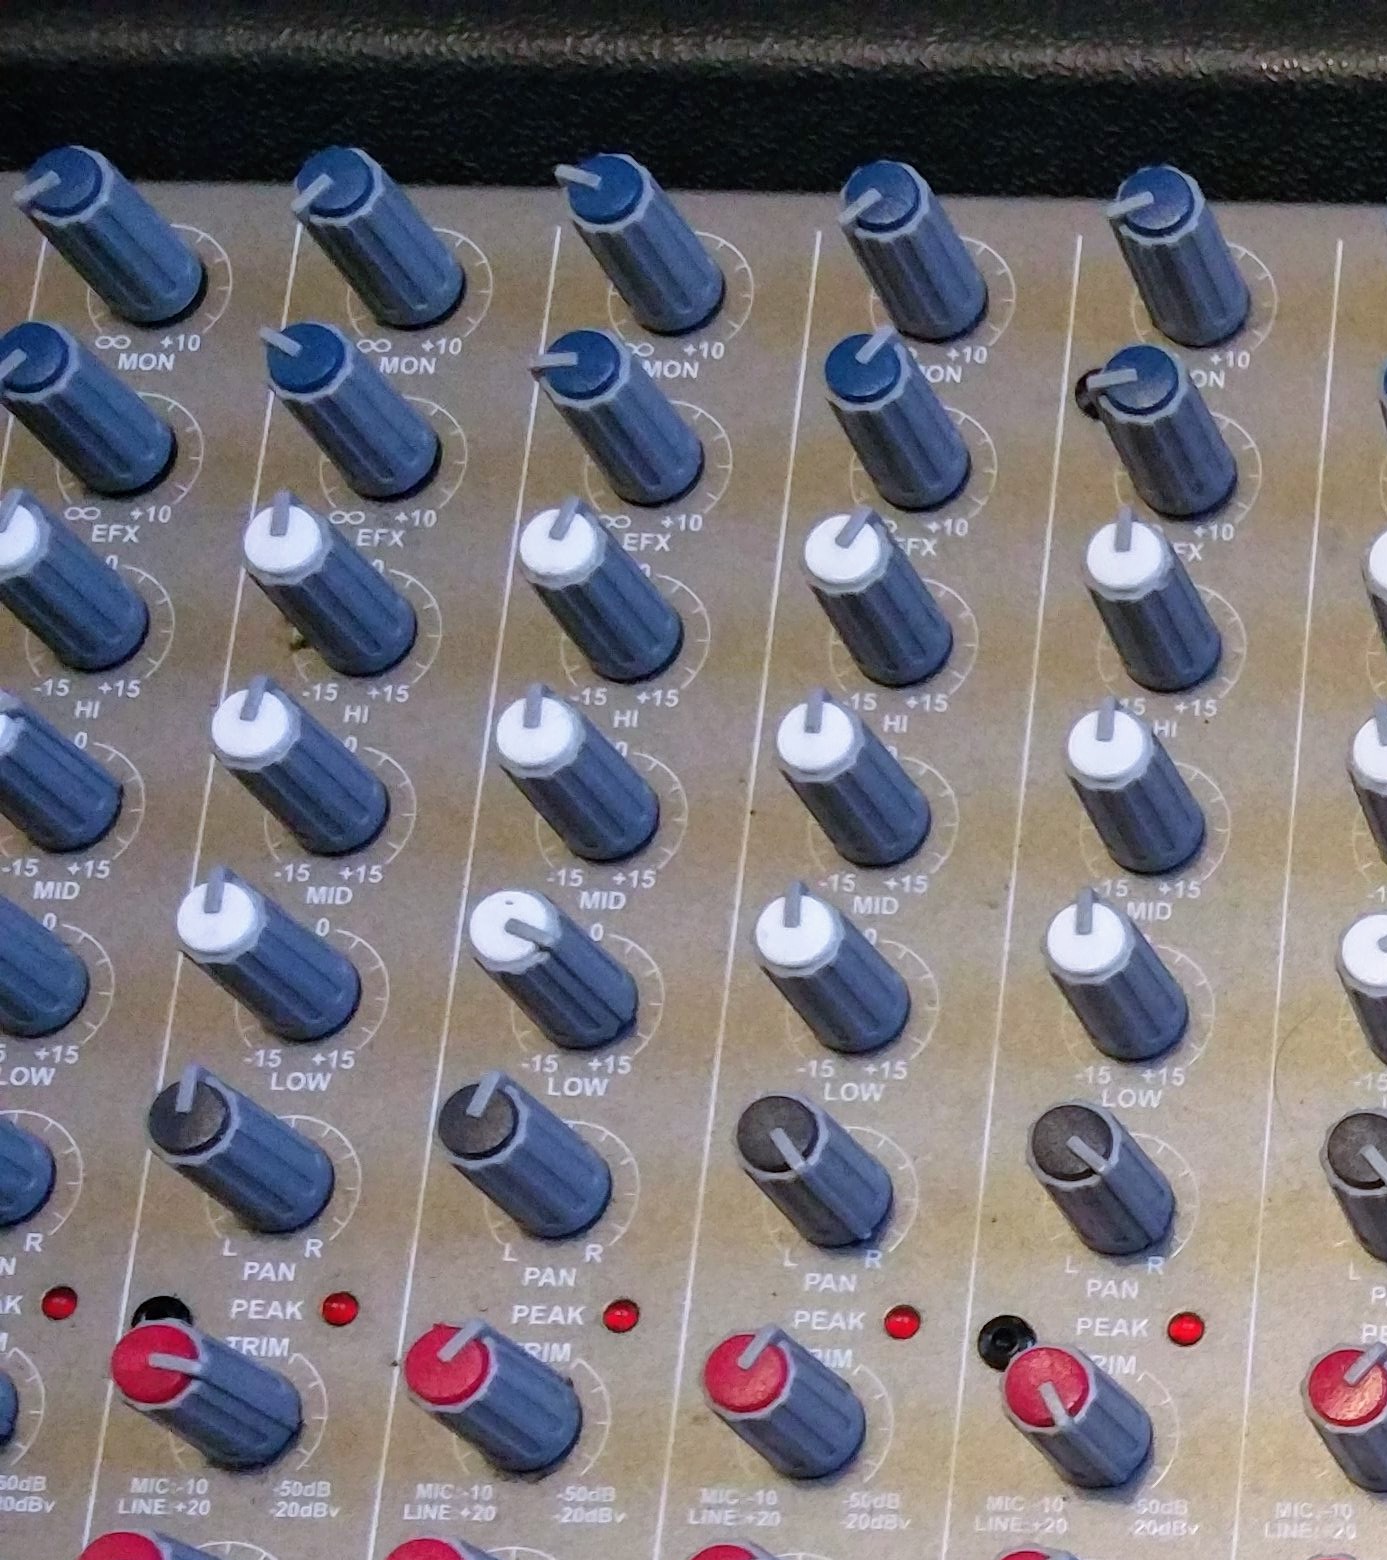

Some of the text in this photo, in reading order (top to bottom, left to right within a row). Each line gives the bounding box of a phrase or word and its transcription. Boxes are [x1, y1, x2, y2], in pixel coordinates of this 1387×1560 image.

[118, 353, 174, 372] MON
[379, 357, 436, 376] MON
[644, 360, 699, 380] MON
[92, 524, 140, 543] EFX
[357, 529, 405, 547] EFX
[622, 533, 672, 552] EFX
[74, 701, 99, 719] HI
[344, 706, 369, 724] HI
[613, 710, 639, 728] HI
[34, 881, 80, 900] MID
[306, 886, 353, 905] MID
[580, 891, 626, 910] MID
[853, 896, 899, 915] MID
[271, 1072, 332, 1091] LOW
[548, 1076, 609, 1096] LOW
[824, 1082, 885, 1102] LOW
[222, 1239, 322, 1257] L R
[243, 1262, 296, 1282] PAN
[522, 1268, 576, 1286] PAN
[804, 1274, 857, 1292] PAN
[1087, 1280, 1139, 1298] PAN
[231, 1300, 304, 1320] PEAK
[512, 1306, 584, 1324] PEAK
[794, 1312, 864, 1330] PEAK
[1077, 1318, 1149, 1336] PEAK
[226, 1338, 290, 1357] TRIM
